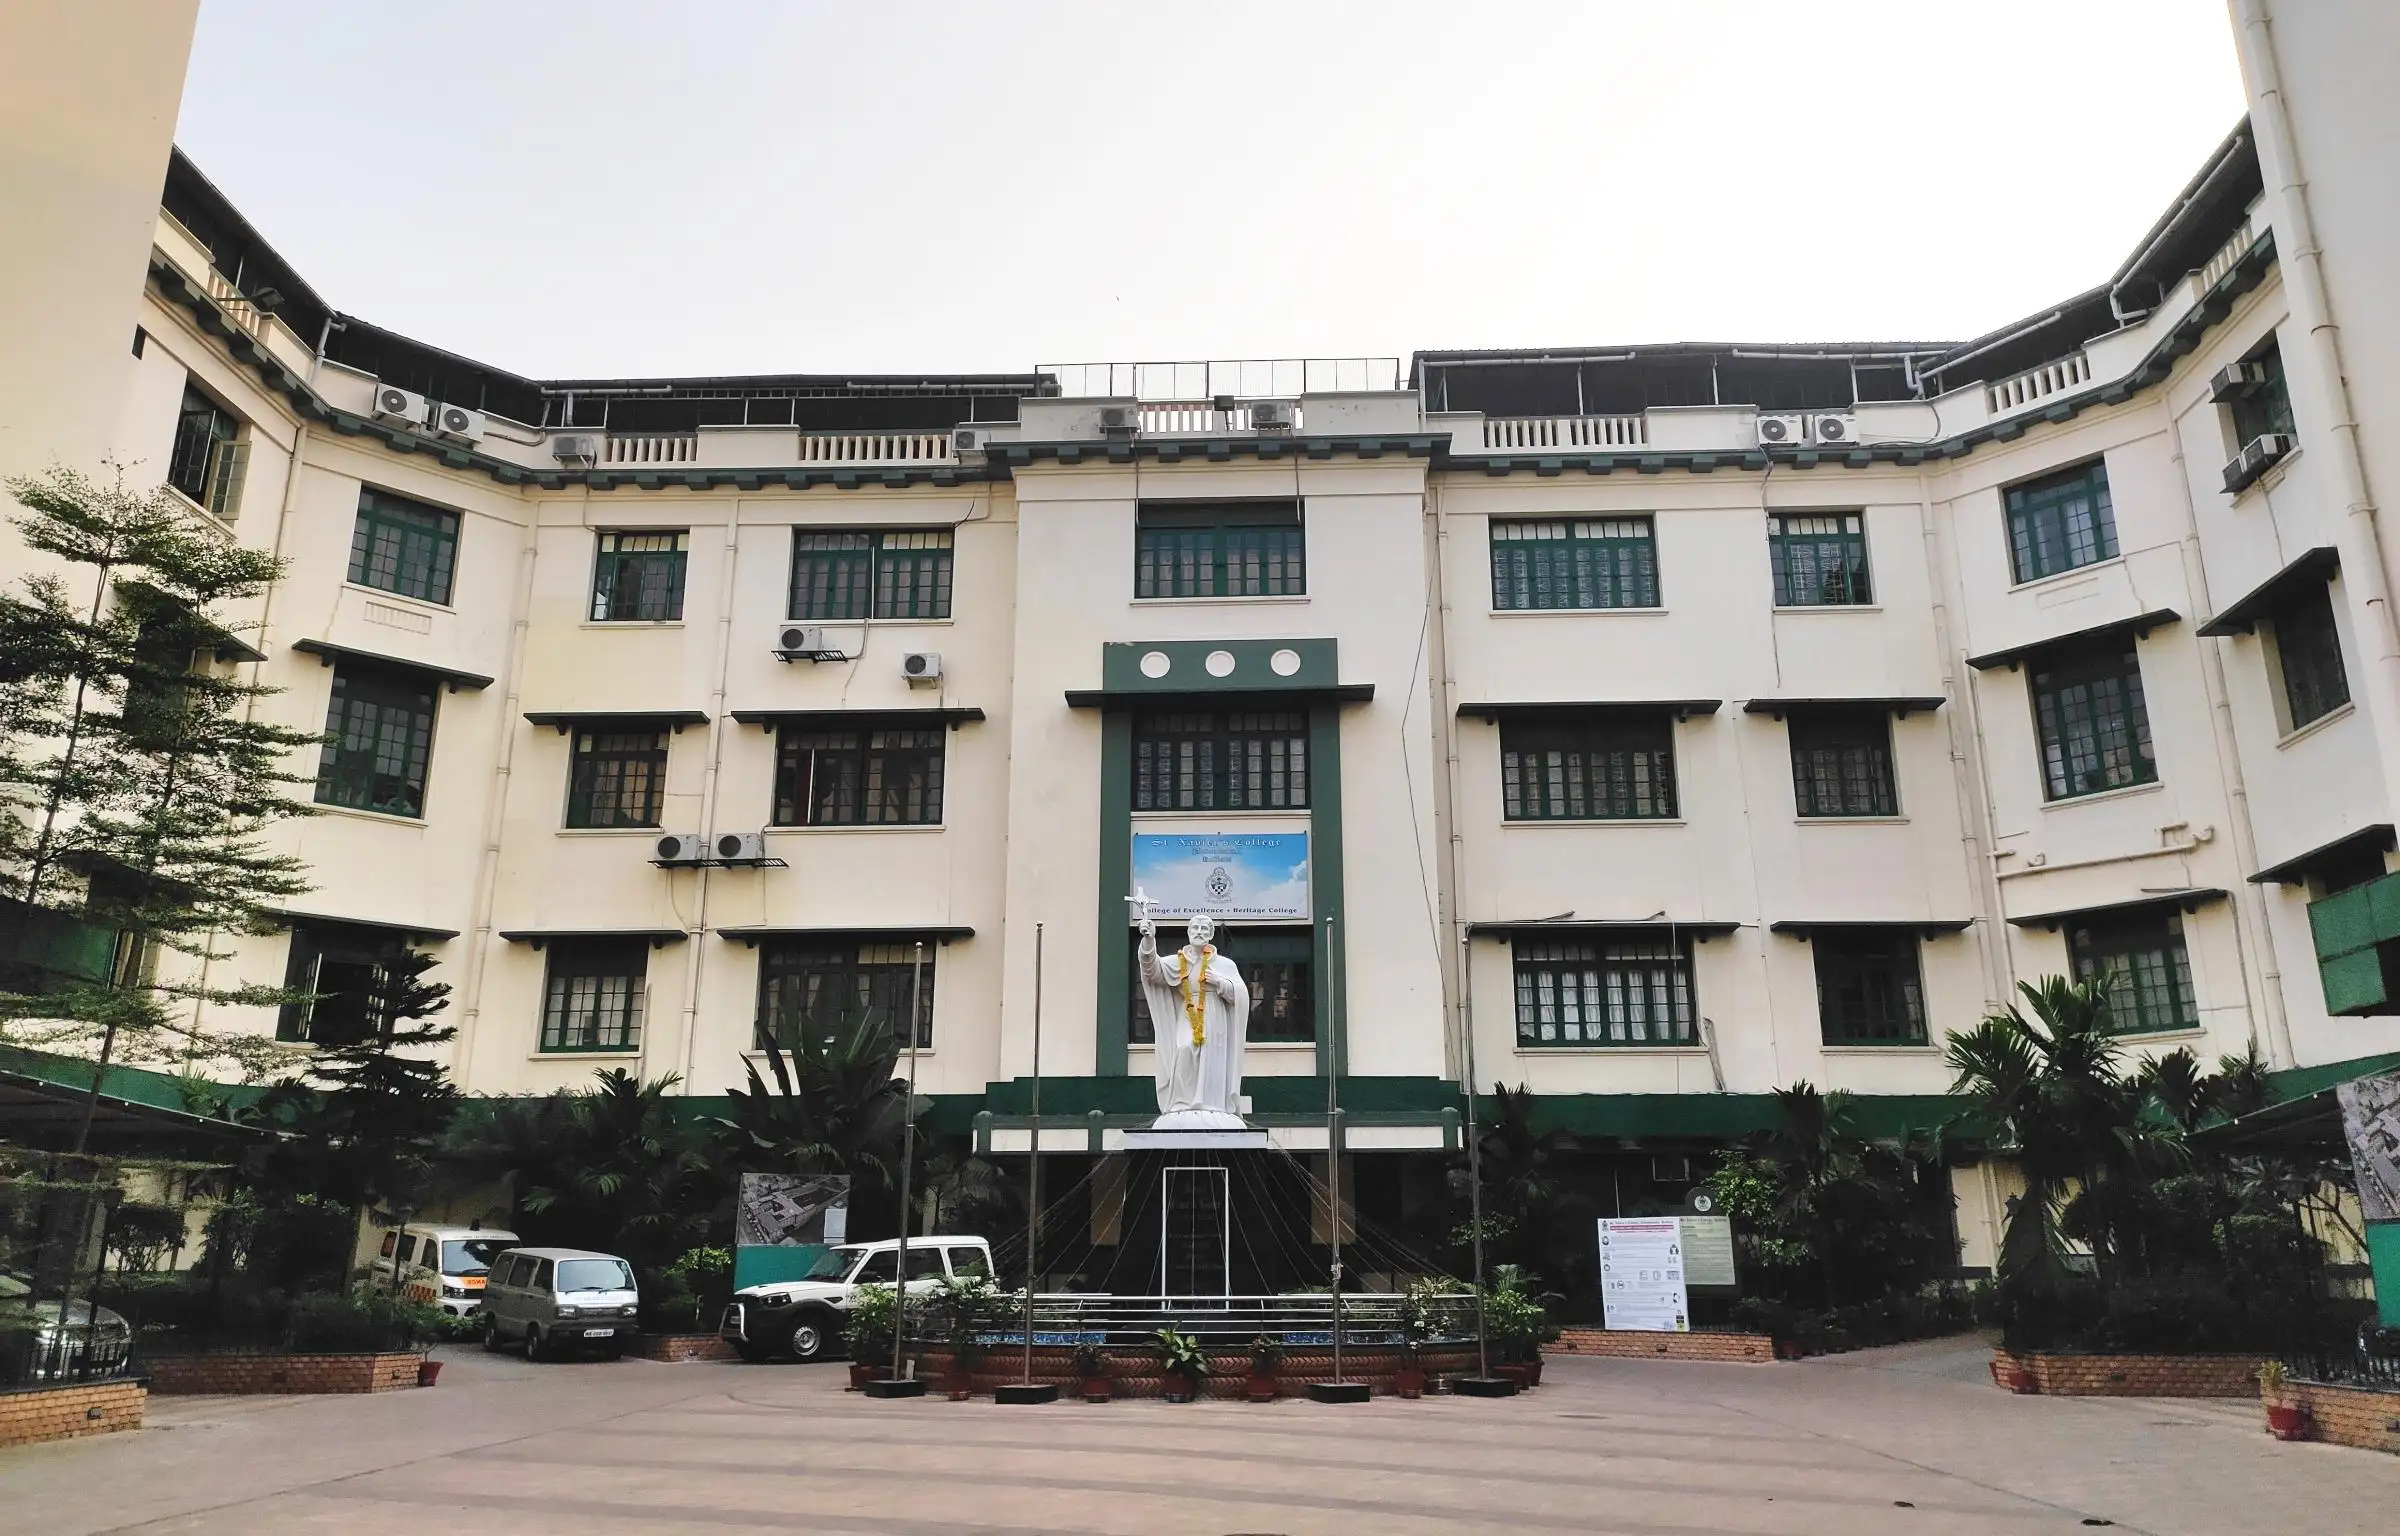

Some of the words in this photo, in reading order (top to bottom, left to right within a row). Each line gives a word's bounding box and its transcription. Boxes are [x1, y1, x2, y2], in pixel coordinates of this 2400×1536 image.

[1233, 837, 1282, 848] College
[1233, 907, 1266, 915] Heritage
[1268, 907, 1298, 915] College
